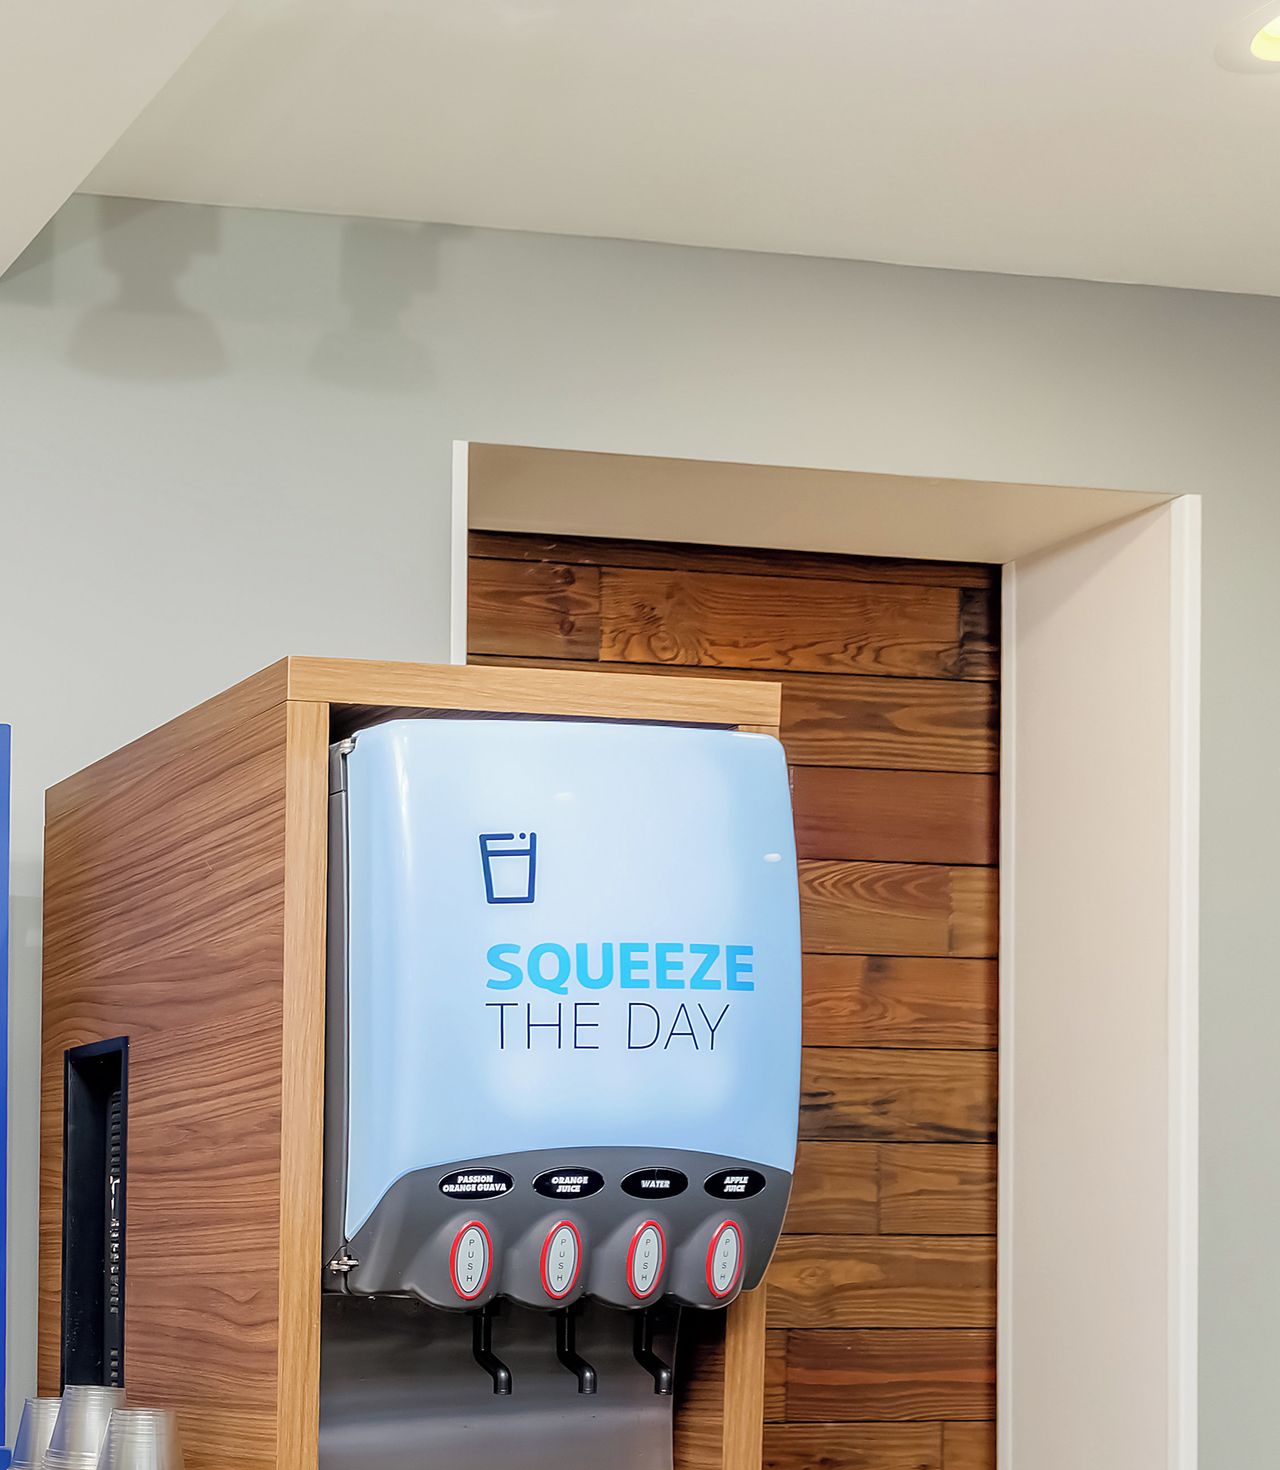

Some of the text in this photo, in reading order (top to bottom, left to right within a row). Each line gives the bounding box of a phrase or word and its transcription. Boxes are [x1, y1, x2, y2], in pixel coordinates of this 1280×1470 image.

[485, 942, 755, 995] SQUEEZE
[485, 1002, 731, 1051] THE DAY
[457, 1175, 494, 1184] PASSION
[551, 1176, 589, 1184] ORANGE
[640, 1180, 671, 1189] WATER
[723, 1176, 749, 1184] APPLE
[442, 1183, 507, 1193] ORANGE GUAVA
[556, 1185, 581, 1193] JUICE
[723, 1184, 746, 1192] JUICE
[466, 1239, 475, 1282] PUSH
[557, 1238, 567, 1282] PUSH
[641, 1238, 651, 1281] PUSH
[720, 1238, 731, 1281] PUSH
